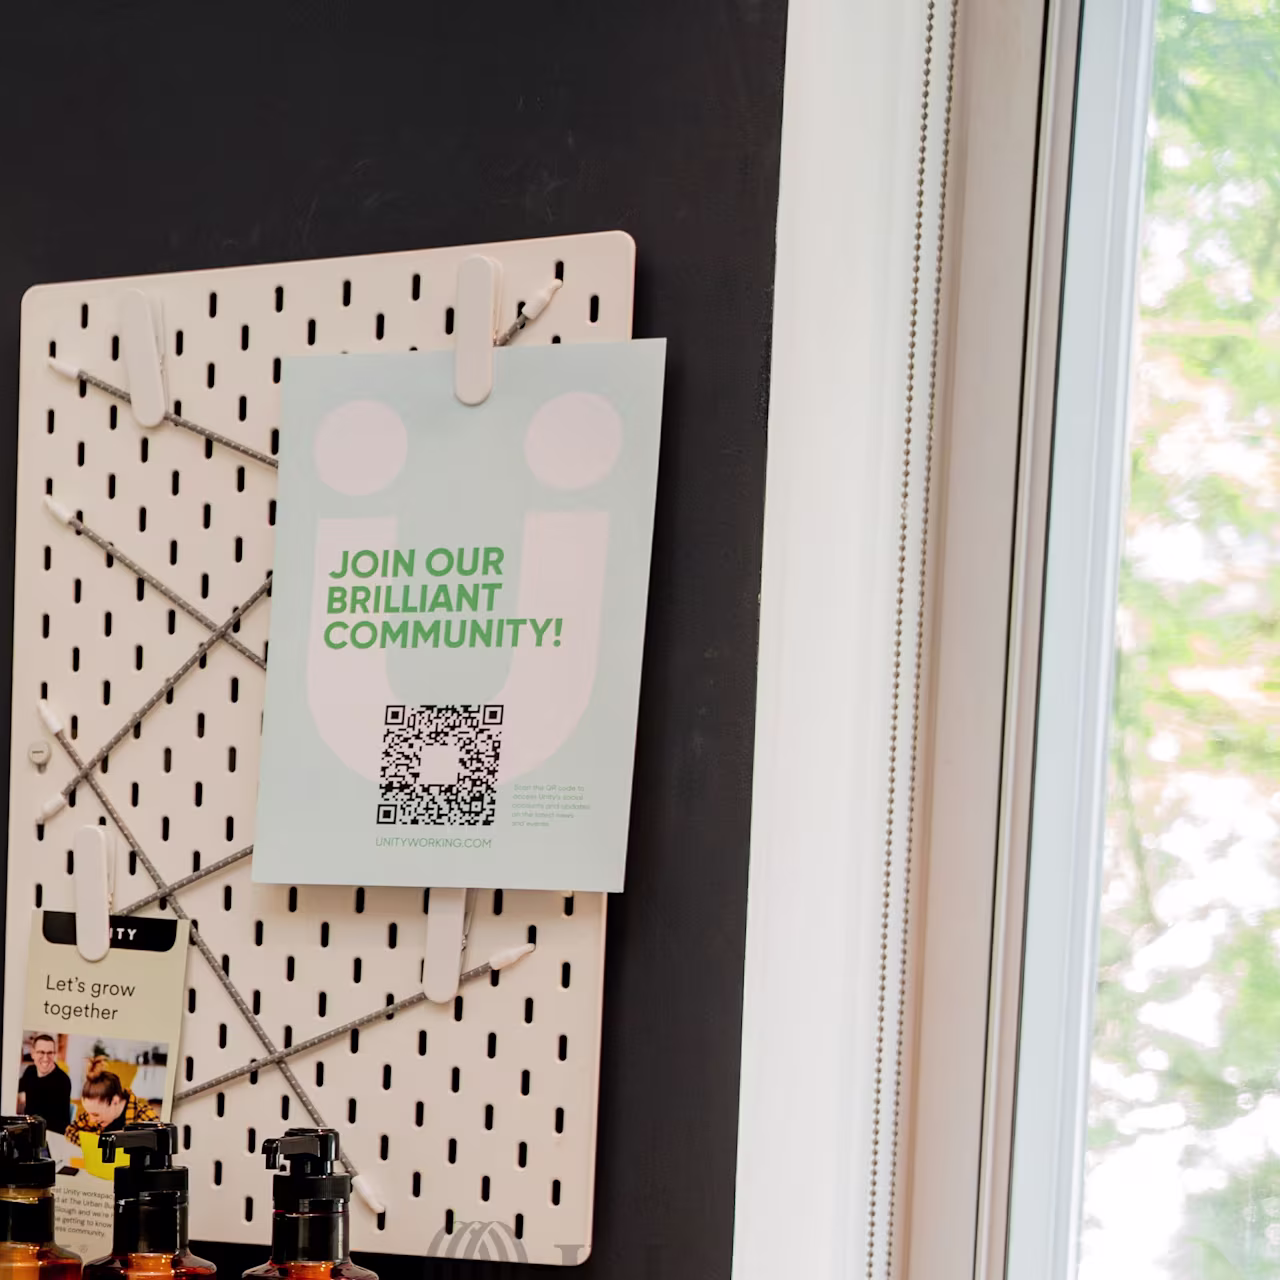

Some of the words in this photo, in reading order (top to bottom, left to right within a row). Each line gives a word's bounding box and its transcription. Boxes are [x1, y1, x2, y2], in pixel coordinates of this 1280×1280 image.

[328, 549, 416, 579] JOIN
[425, 547, 505, 577] OUR
[327, 583, 503, 614] BRILLIANT
[323, 618, 563, 650] COMMUNITY!
[375, 837, 492, 849] UNITYWORKING.COM
[46, 974, 85, 993] Let's
[91, 982, 136, 998] grow
[43, 1000, 118, 1020] together
[82, 1191, 113, 1199] workspac
